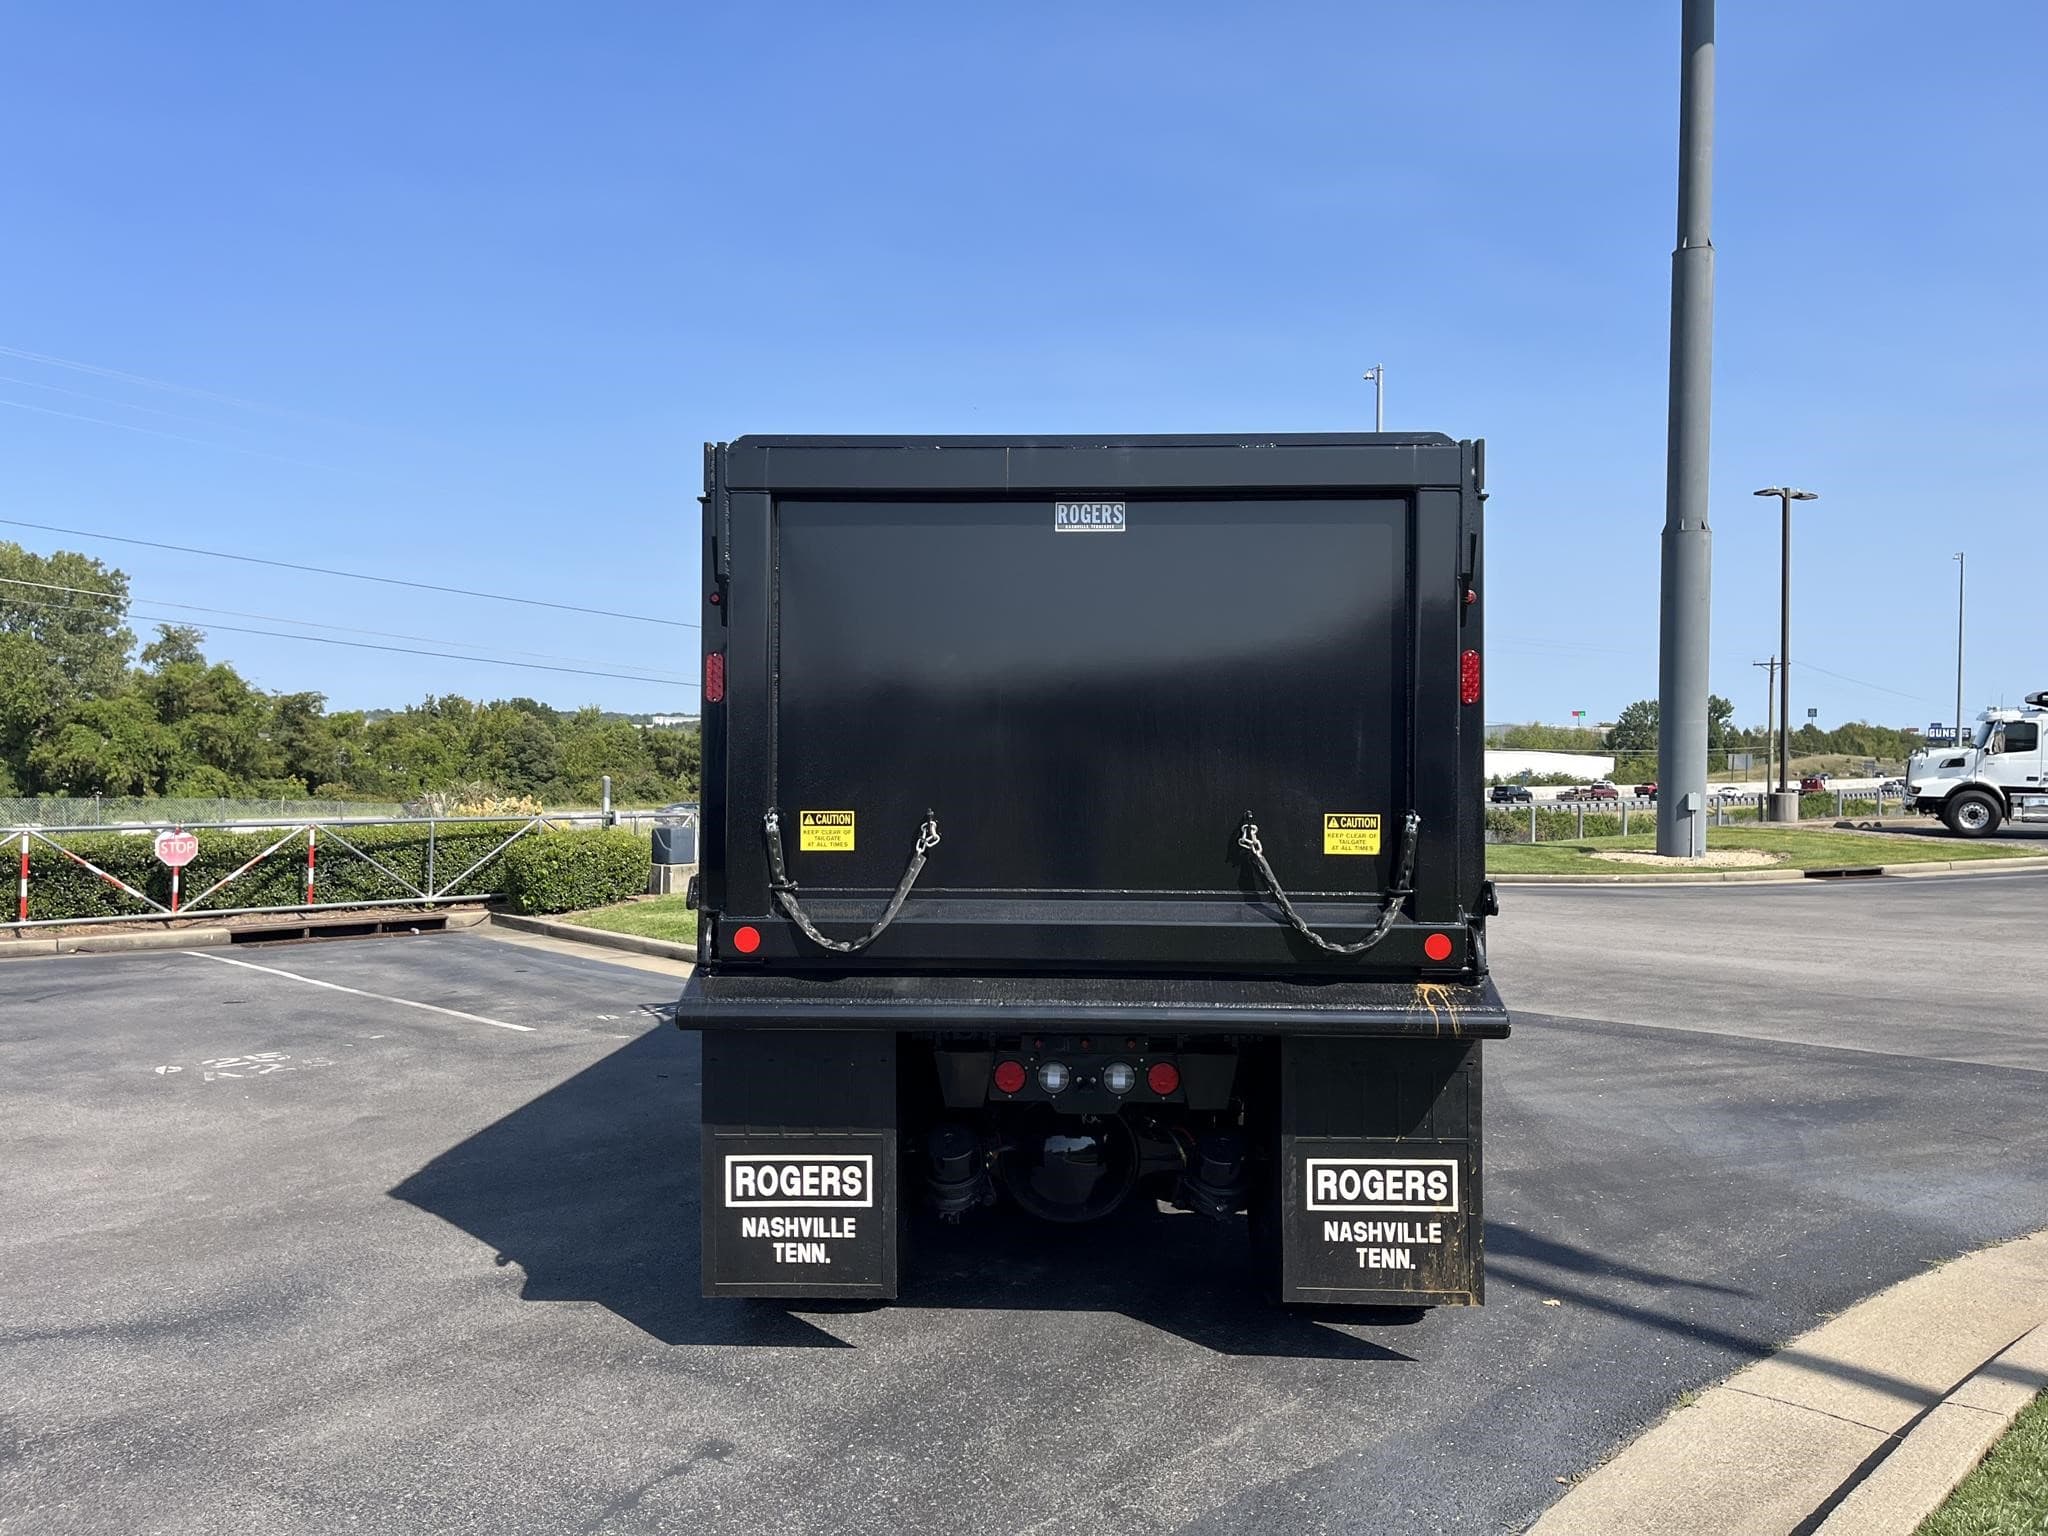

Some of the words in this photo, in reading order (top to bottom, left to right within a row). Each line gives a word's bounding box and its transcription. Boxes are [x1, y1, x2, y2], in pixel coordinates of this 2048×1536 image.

[1058, 504, 1123, 524] ROGERS
[1929, 728, 1956, 738] GUNS
[815, 814, 851, 825] CAUTION
[1340, 817, 1377, 828] CAUTION
[160, 841, 194, 855] STOP
[735, 1165, 863, 1197] ROGERS
[1317, 1169, 1448, 1201] ROGERS
[742, 1217, 856, 1238] NASHVILLE
[1323, 1221, 1442, 1244] NASHVILLE
[772, 1242, 831, 1264] TENN.
[1356, 1247, 1417, 1270] TENN.
